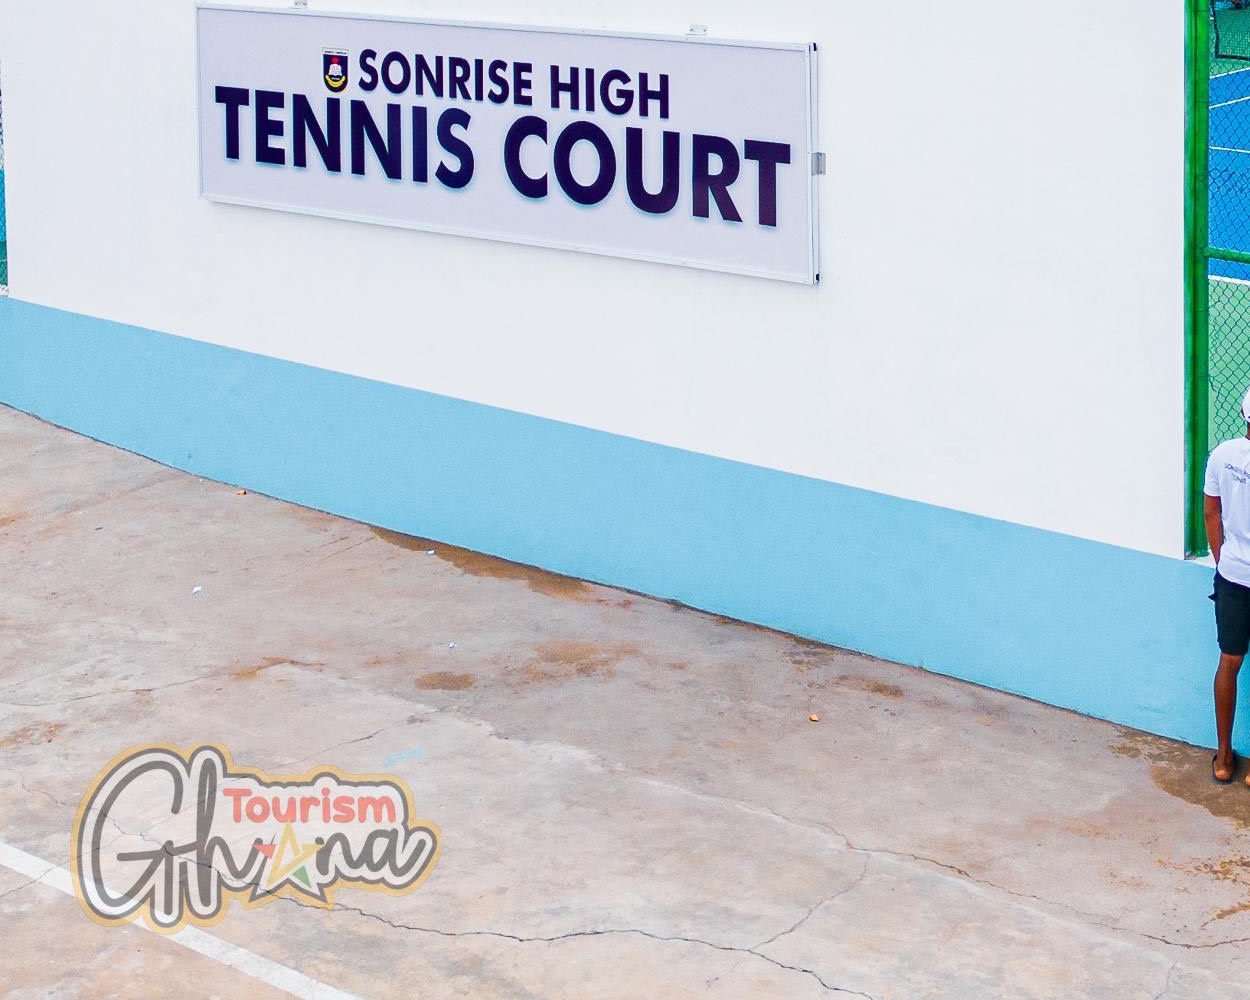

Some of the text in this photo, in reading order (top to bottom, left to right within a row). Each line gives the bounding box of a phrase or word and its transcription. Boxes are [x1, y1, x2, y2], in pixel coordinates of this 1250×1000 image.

[358, 48, 669, 120] SONRISE HIGH
[214, 85, 791, 228] TENNIS COURT
